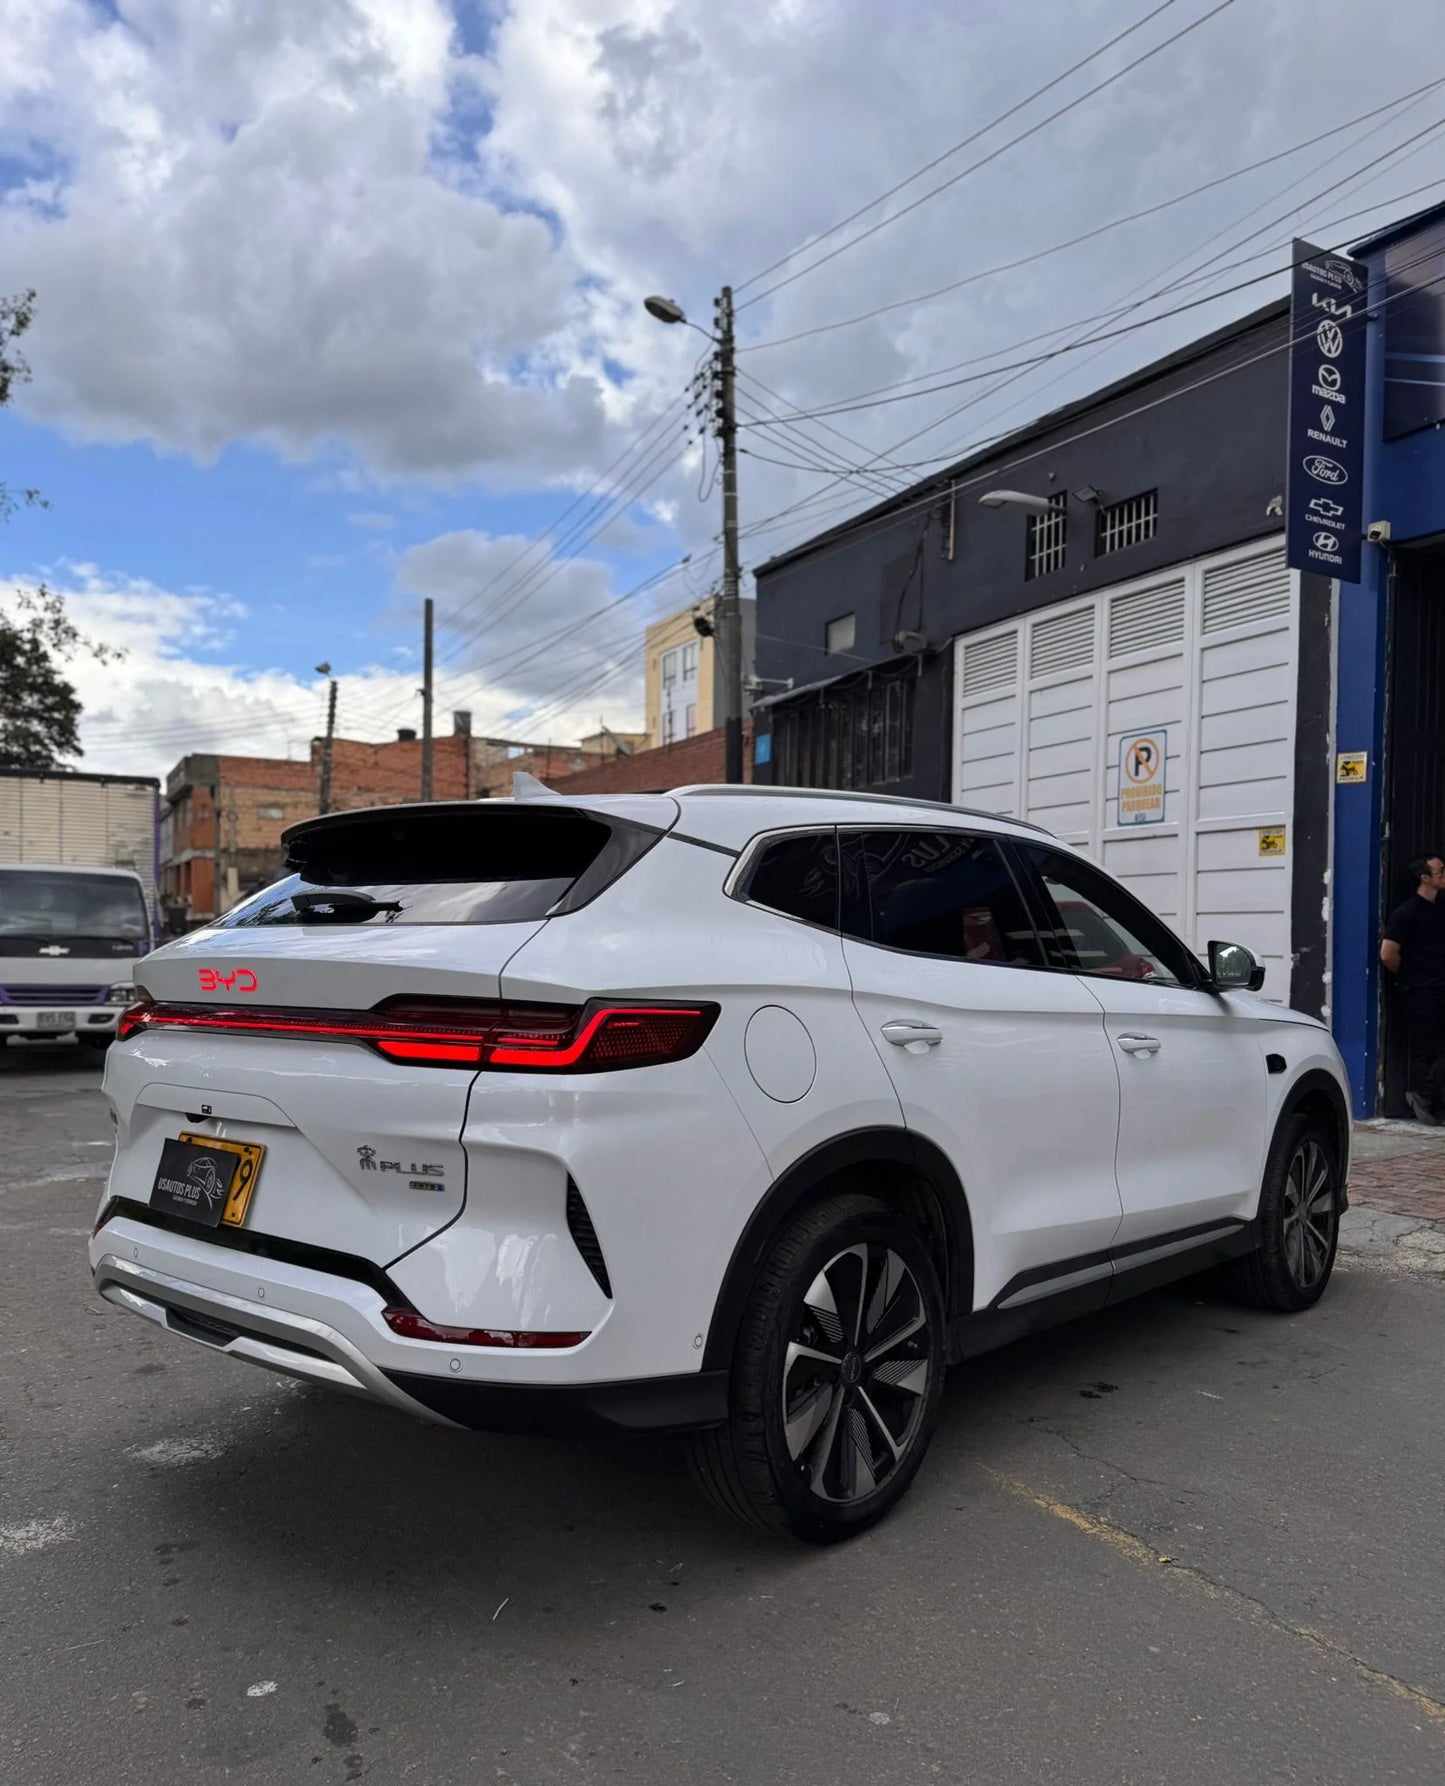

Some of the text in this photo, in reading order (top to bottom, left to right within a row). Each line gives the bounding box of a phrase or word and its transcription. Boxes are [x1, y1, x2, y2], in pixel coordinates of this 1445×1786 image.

[1307, 428, 1348, 448] RENAULT
[1311, 458, 1341, 482] Ford
[1305, 513, 1346, 530] CHEVROLET
[1308, 549, 1342, 565] HYUNDAI
[198, 969, 258, 992] BYD
[380, 1161, 445, 1177] PLUS
[157, 1177, 186, 1196] USAUTOS
[184, 1184, 202, 1200] PLUS
